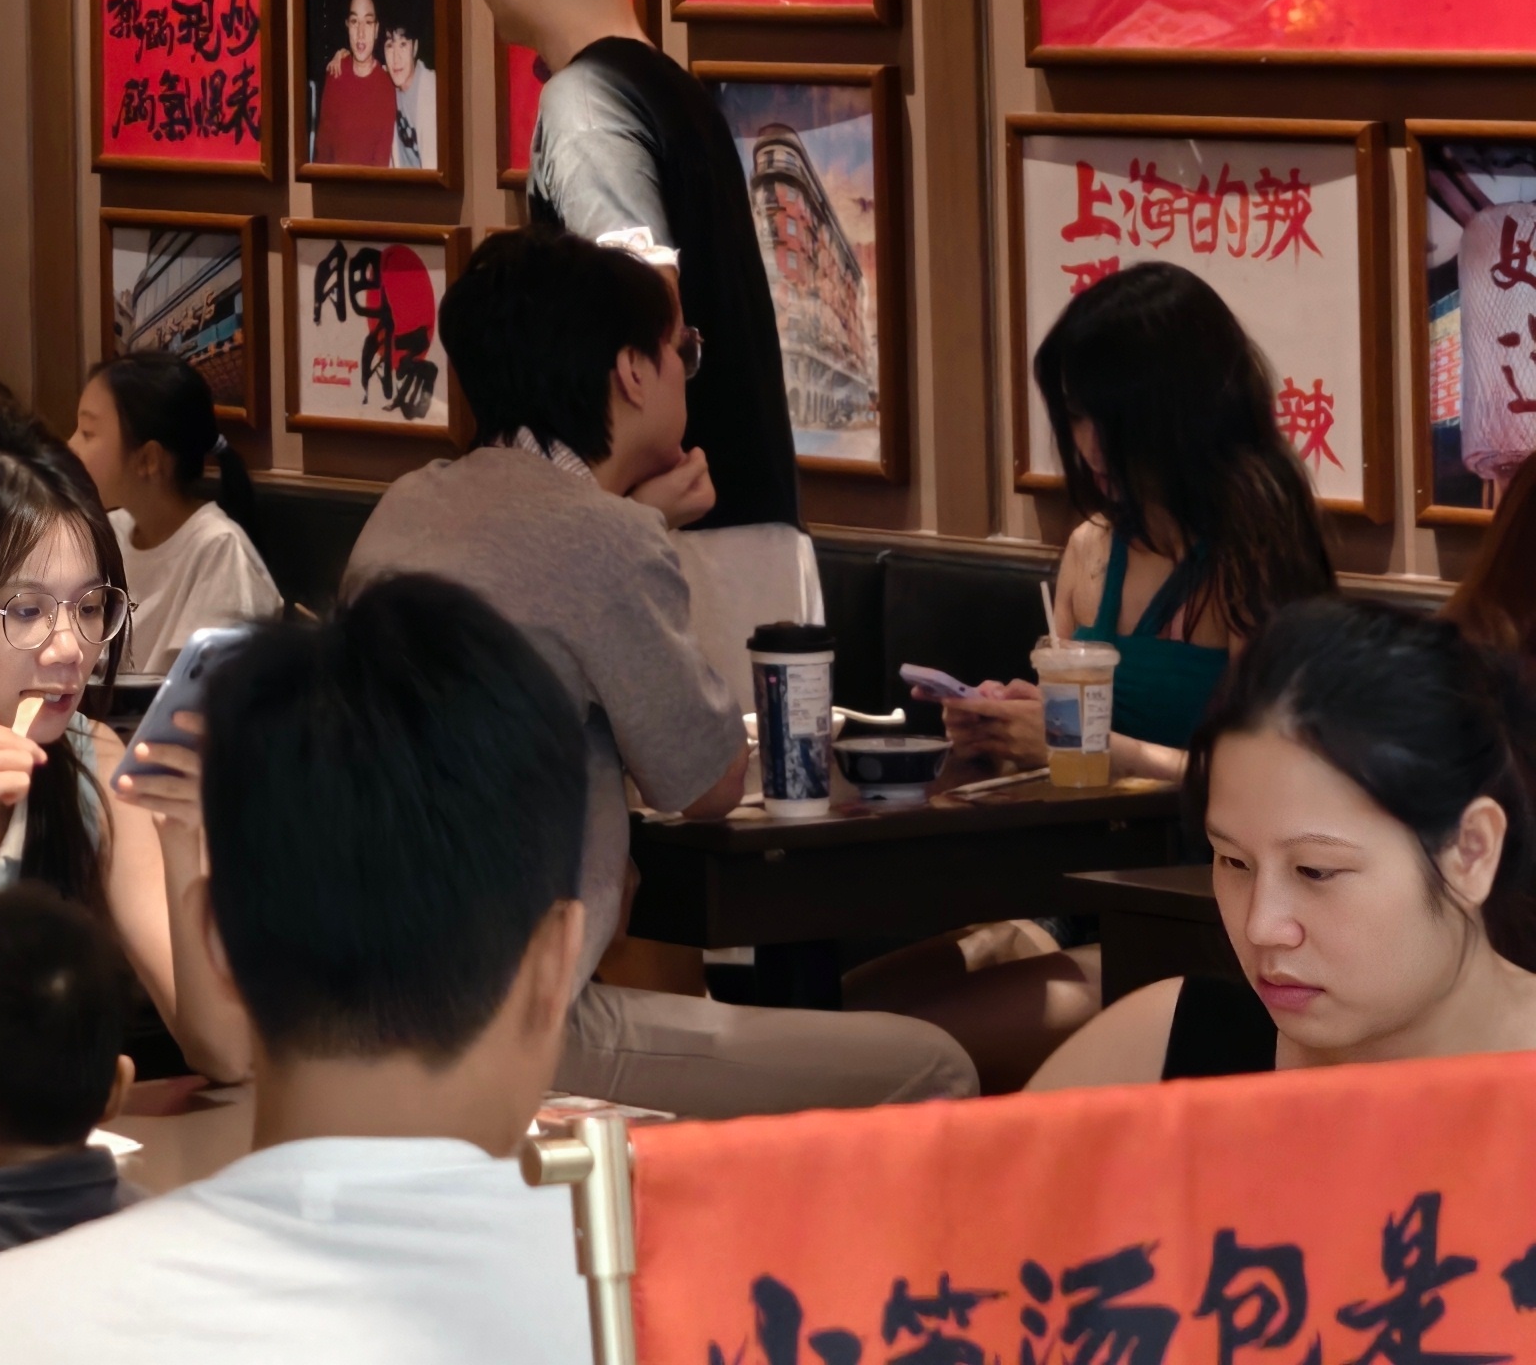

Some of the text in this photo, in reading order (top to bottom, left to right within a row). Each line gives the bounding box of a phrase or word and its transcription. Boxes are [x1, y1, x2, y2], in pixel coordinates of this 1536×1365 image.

[1061, 157, 1324, 266] 上海的辣
[707, 1191, 1536, 1365] 小笼汤包是
